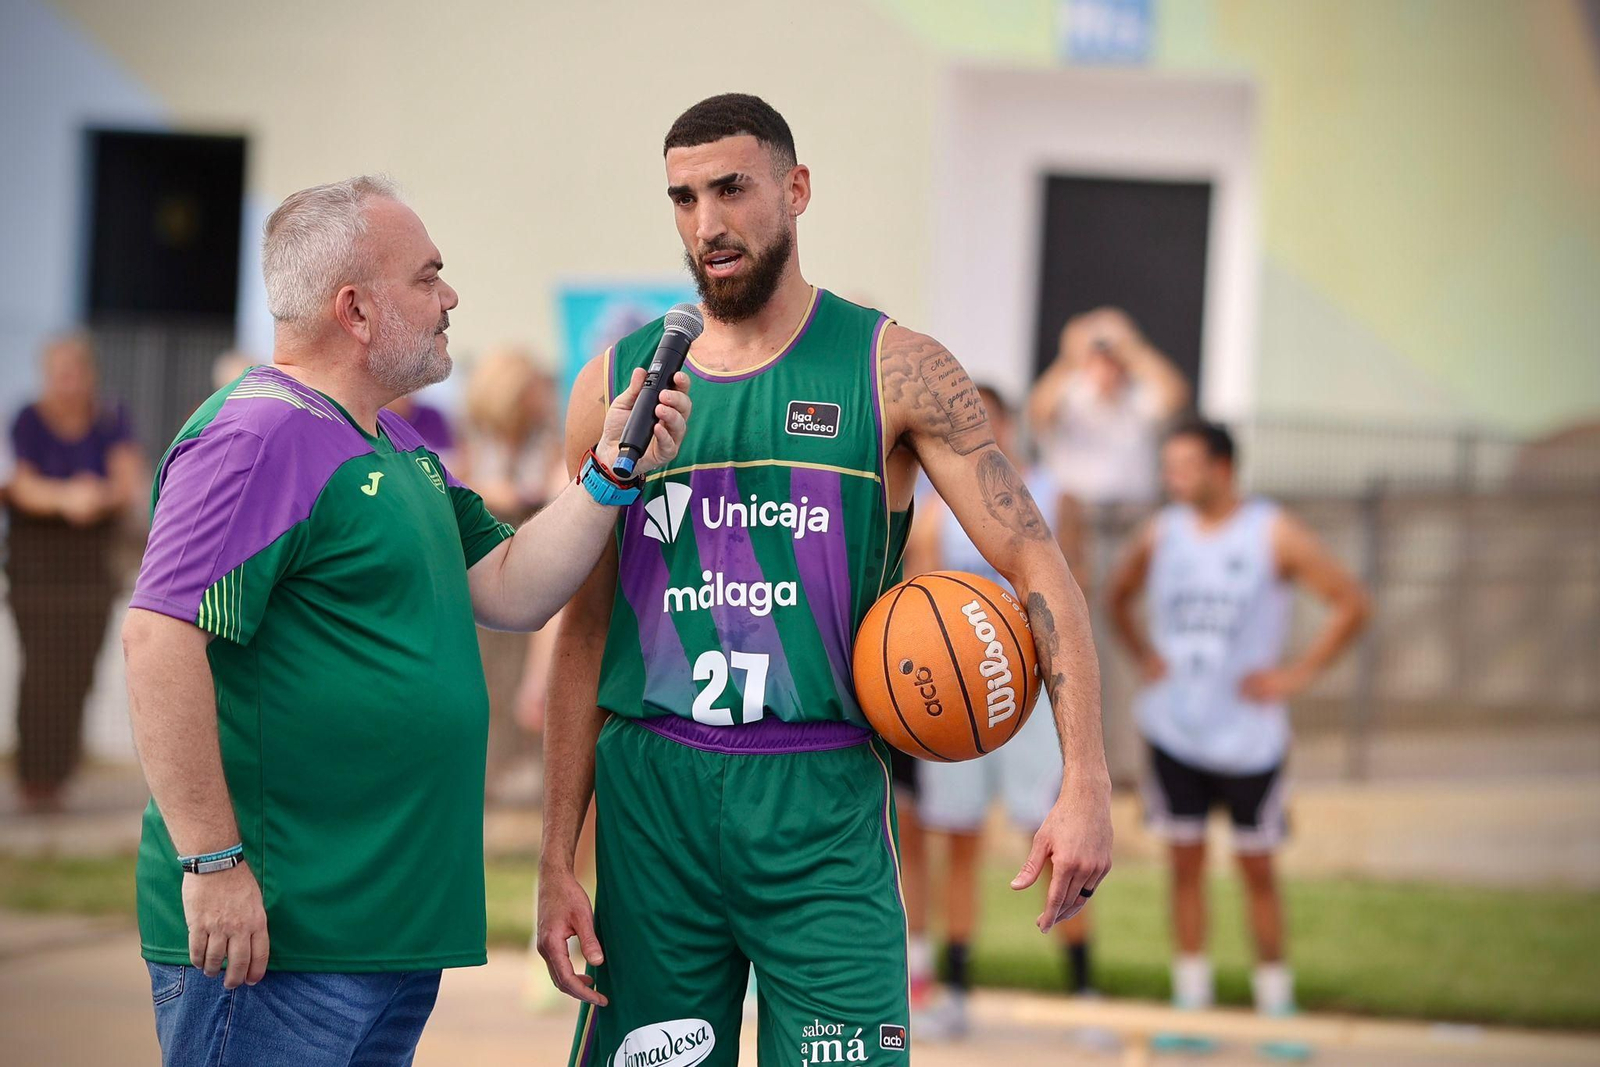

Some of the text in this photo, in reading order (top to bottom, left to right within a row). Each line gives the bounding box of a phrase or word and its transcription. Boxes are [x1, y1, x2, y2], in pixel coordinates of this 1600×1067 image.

[791, 421, 834, 433] endesa
[792, 411, 812, 422] liga
[702, 494, 830, 539] Unicaja
[692, 650, 769, 726] 27
[914, 666, 943, 717] acb
[800, 1027, 869, 1063] a má
[802, 1019, 845, 1037] sabor
[883, 1035, 902, 1047] acb
[624, 1026, 709, 1067] famadesa
